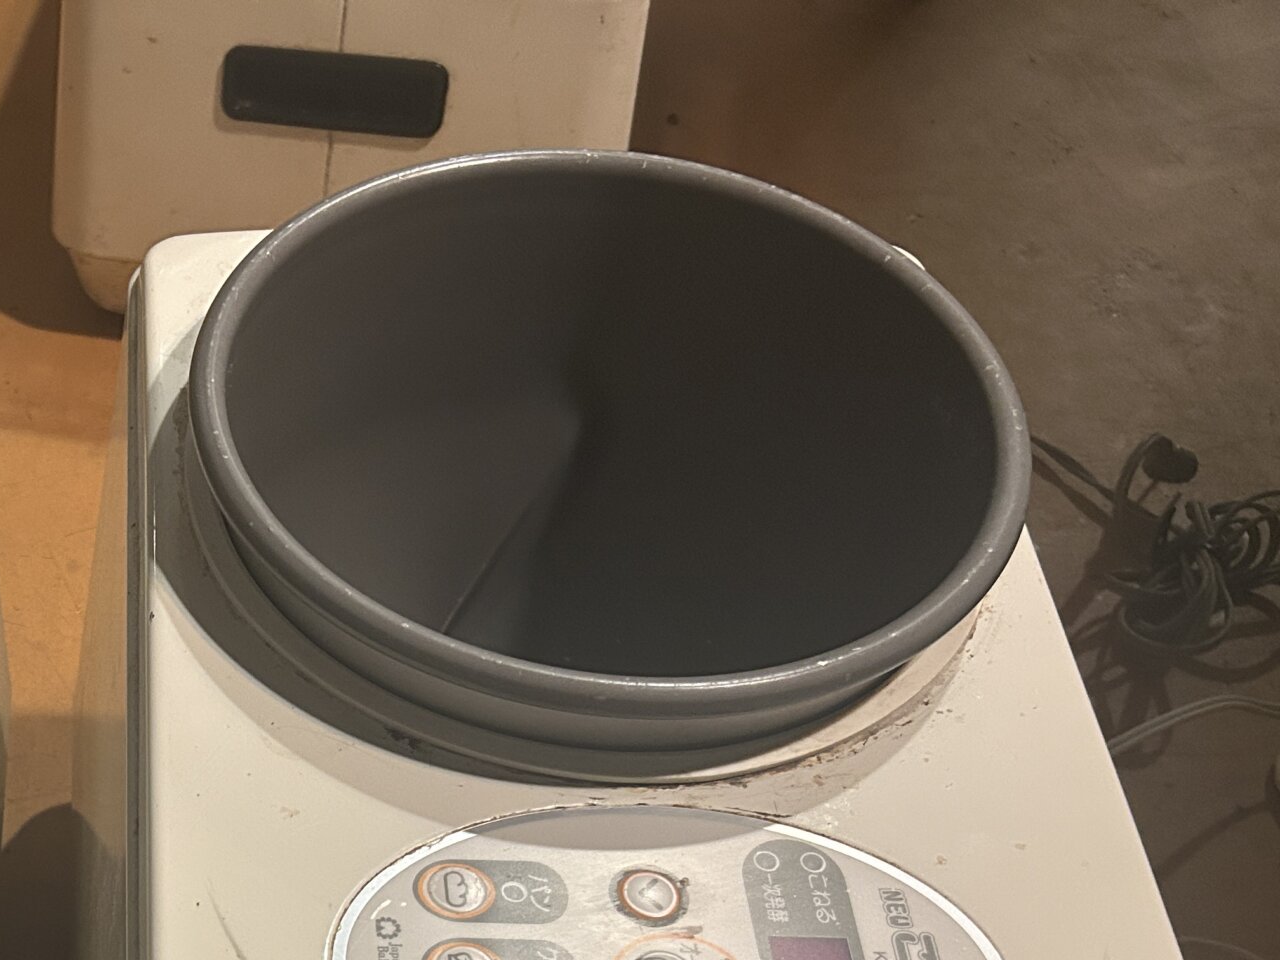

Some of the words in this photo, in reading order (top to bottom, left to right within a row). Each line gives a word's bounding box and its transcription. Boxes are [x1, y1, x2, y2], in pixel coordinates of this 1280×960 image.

[528, 874, 552, 912] パン
[808, 874, 836, 923] こねる
